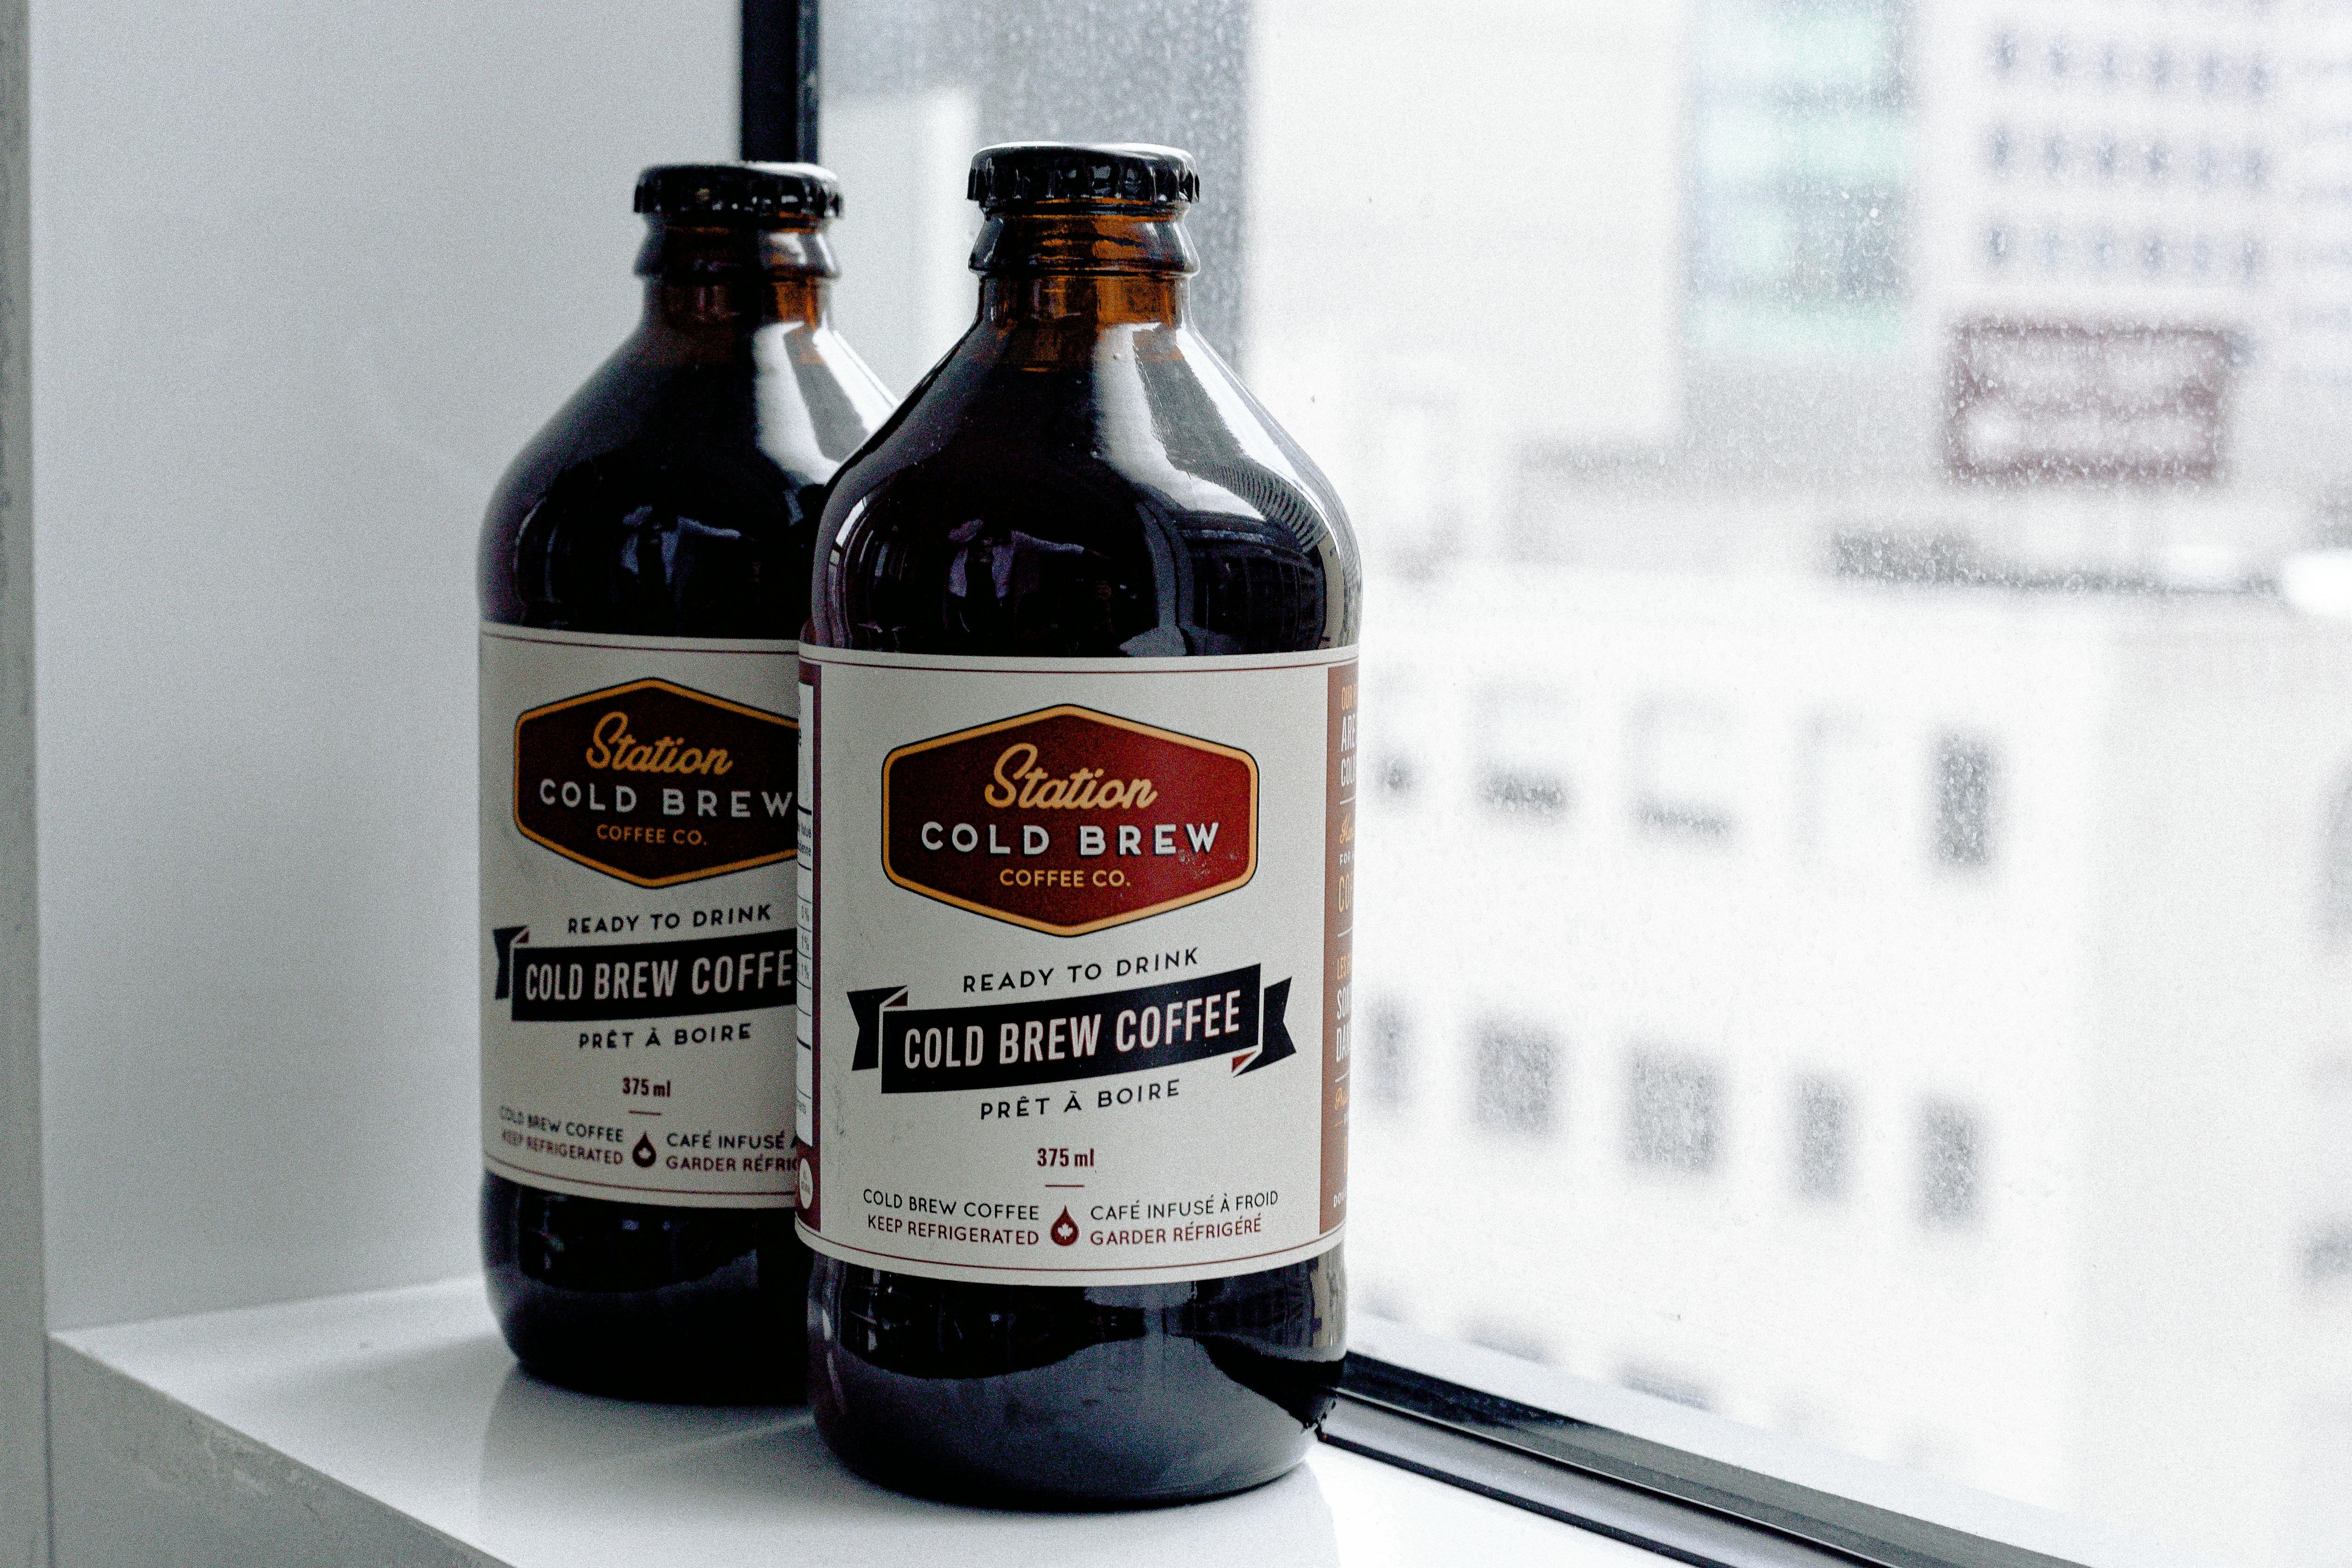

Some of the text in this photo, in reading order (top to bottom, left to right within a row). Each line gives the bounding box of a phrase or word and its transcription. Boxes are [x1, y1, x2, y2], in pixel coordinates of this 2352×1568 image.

[586, 711, 733, 775] Station
[985, 742, 1158, 810] Station
[540, 779, 792, 817] COLD BREW
[596, 824, 707, 845] COFFEE CO.
[922, 821, 1219, 856] COLD BREW
[1000, 869, 1131, 887] COFFEE CO.
[568, 904, 771, 934] READY TO DRINK
[526, 964, 583, 1000] COLD
[594, 960, 679, 1000] BREW
[963, 947, 1198, 993] READY TO DRINK
[579, 1030, 634, 1048] PRÊT
[674, 1023, 751, 1045] BOIRE
[904, 989, 1240, 1069] COLD BREW COFFEE
[623, 1077, 671, 1097] 375 ml
[980, 1079, 1179, 1120] PRÊT À BOIRE
[527, 1115, 560, 1132] BREW
[566, 1122, 623, 1143] COFFEE
[666, 1131, 711, 1149] CAFÉ
[719, 1130, 785, 1150] INFUSÉ
[527, 1136, 623, 1165] REFRIGERATED
[666, 1156, 736, 1171] GARDER
[1037, 1147, 1094, 1167] 375 ml
[863, 1188, 1038, 1220] COLD BREW COFFEE
[1090, 1190, 1278, 1221] CAFÉ INFUSÉ À FROID
[868, 1215, 1039, 1245] KEEP REFRIGERATED
[1090, 1214, 1261, 1246] GARDER RÉFRIGÉRÉ
